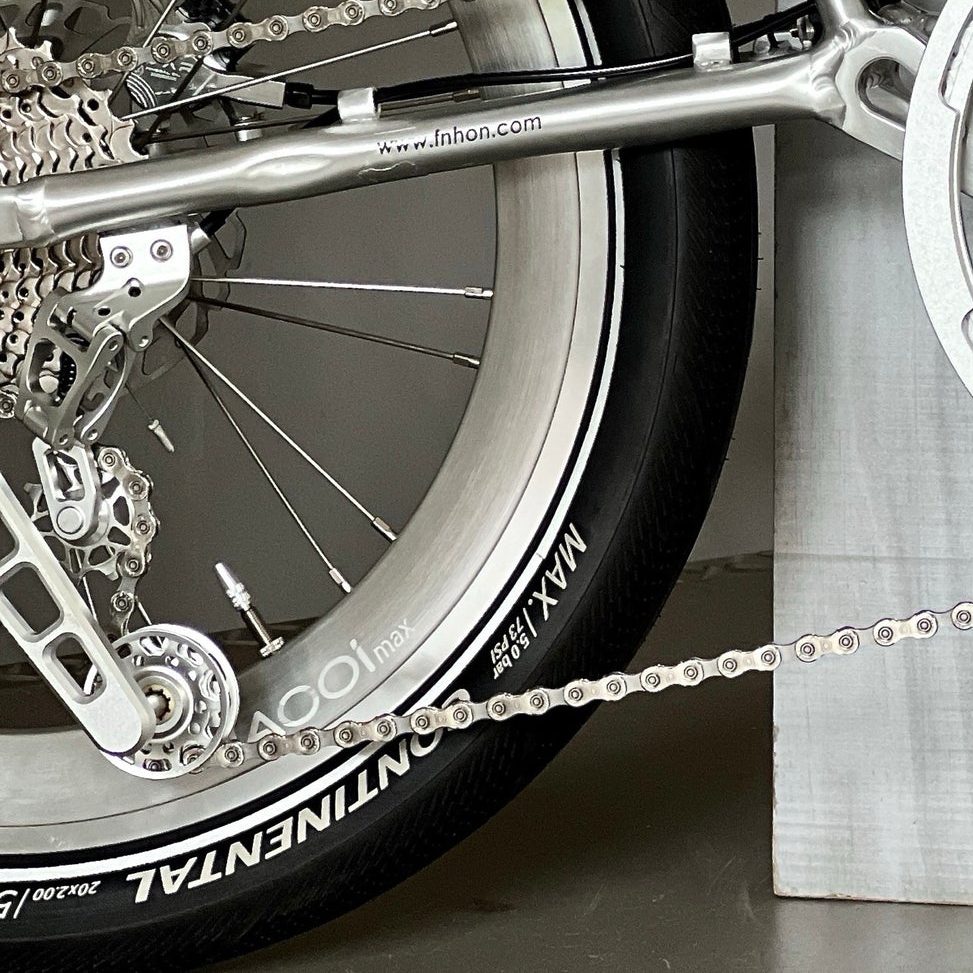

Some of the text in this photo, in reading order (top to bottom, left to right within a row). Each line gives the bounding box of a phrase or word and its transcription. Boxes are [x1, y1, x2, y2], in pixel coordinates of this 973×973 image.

[377, 116, 542, 155] www.fnhon.com
[490, 616, 524, 664] 73 PSI
[229, 619, 415, 743] AOOi max
[493, 654, 513, 680] bar
